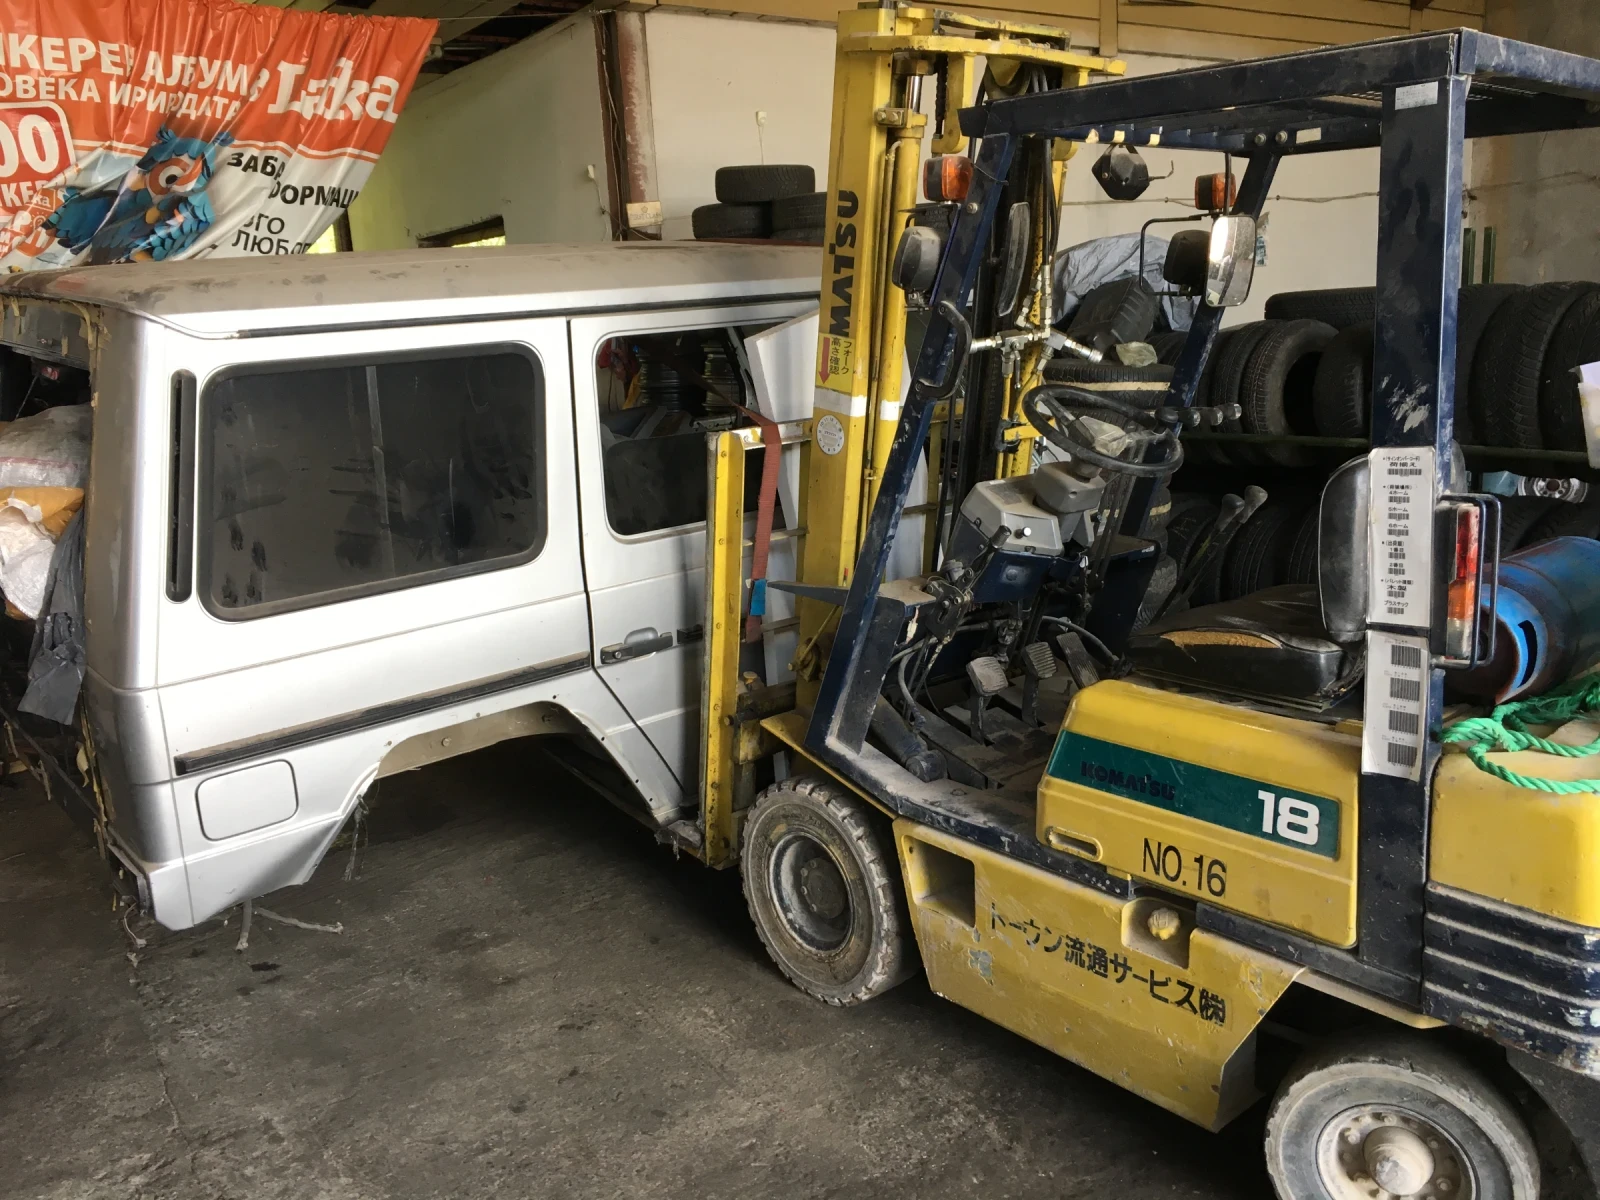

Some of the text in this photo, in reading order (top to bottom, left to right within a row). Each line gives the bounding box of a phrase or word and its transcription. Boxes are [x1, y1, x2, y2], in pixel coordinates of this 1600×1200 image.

[829, 189, 859, 338] MATSU
[1080, 760, 1176, 801] KOMATSU
[1257, 790, 1320, 846] 18
